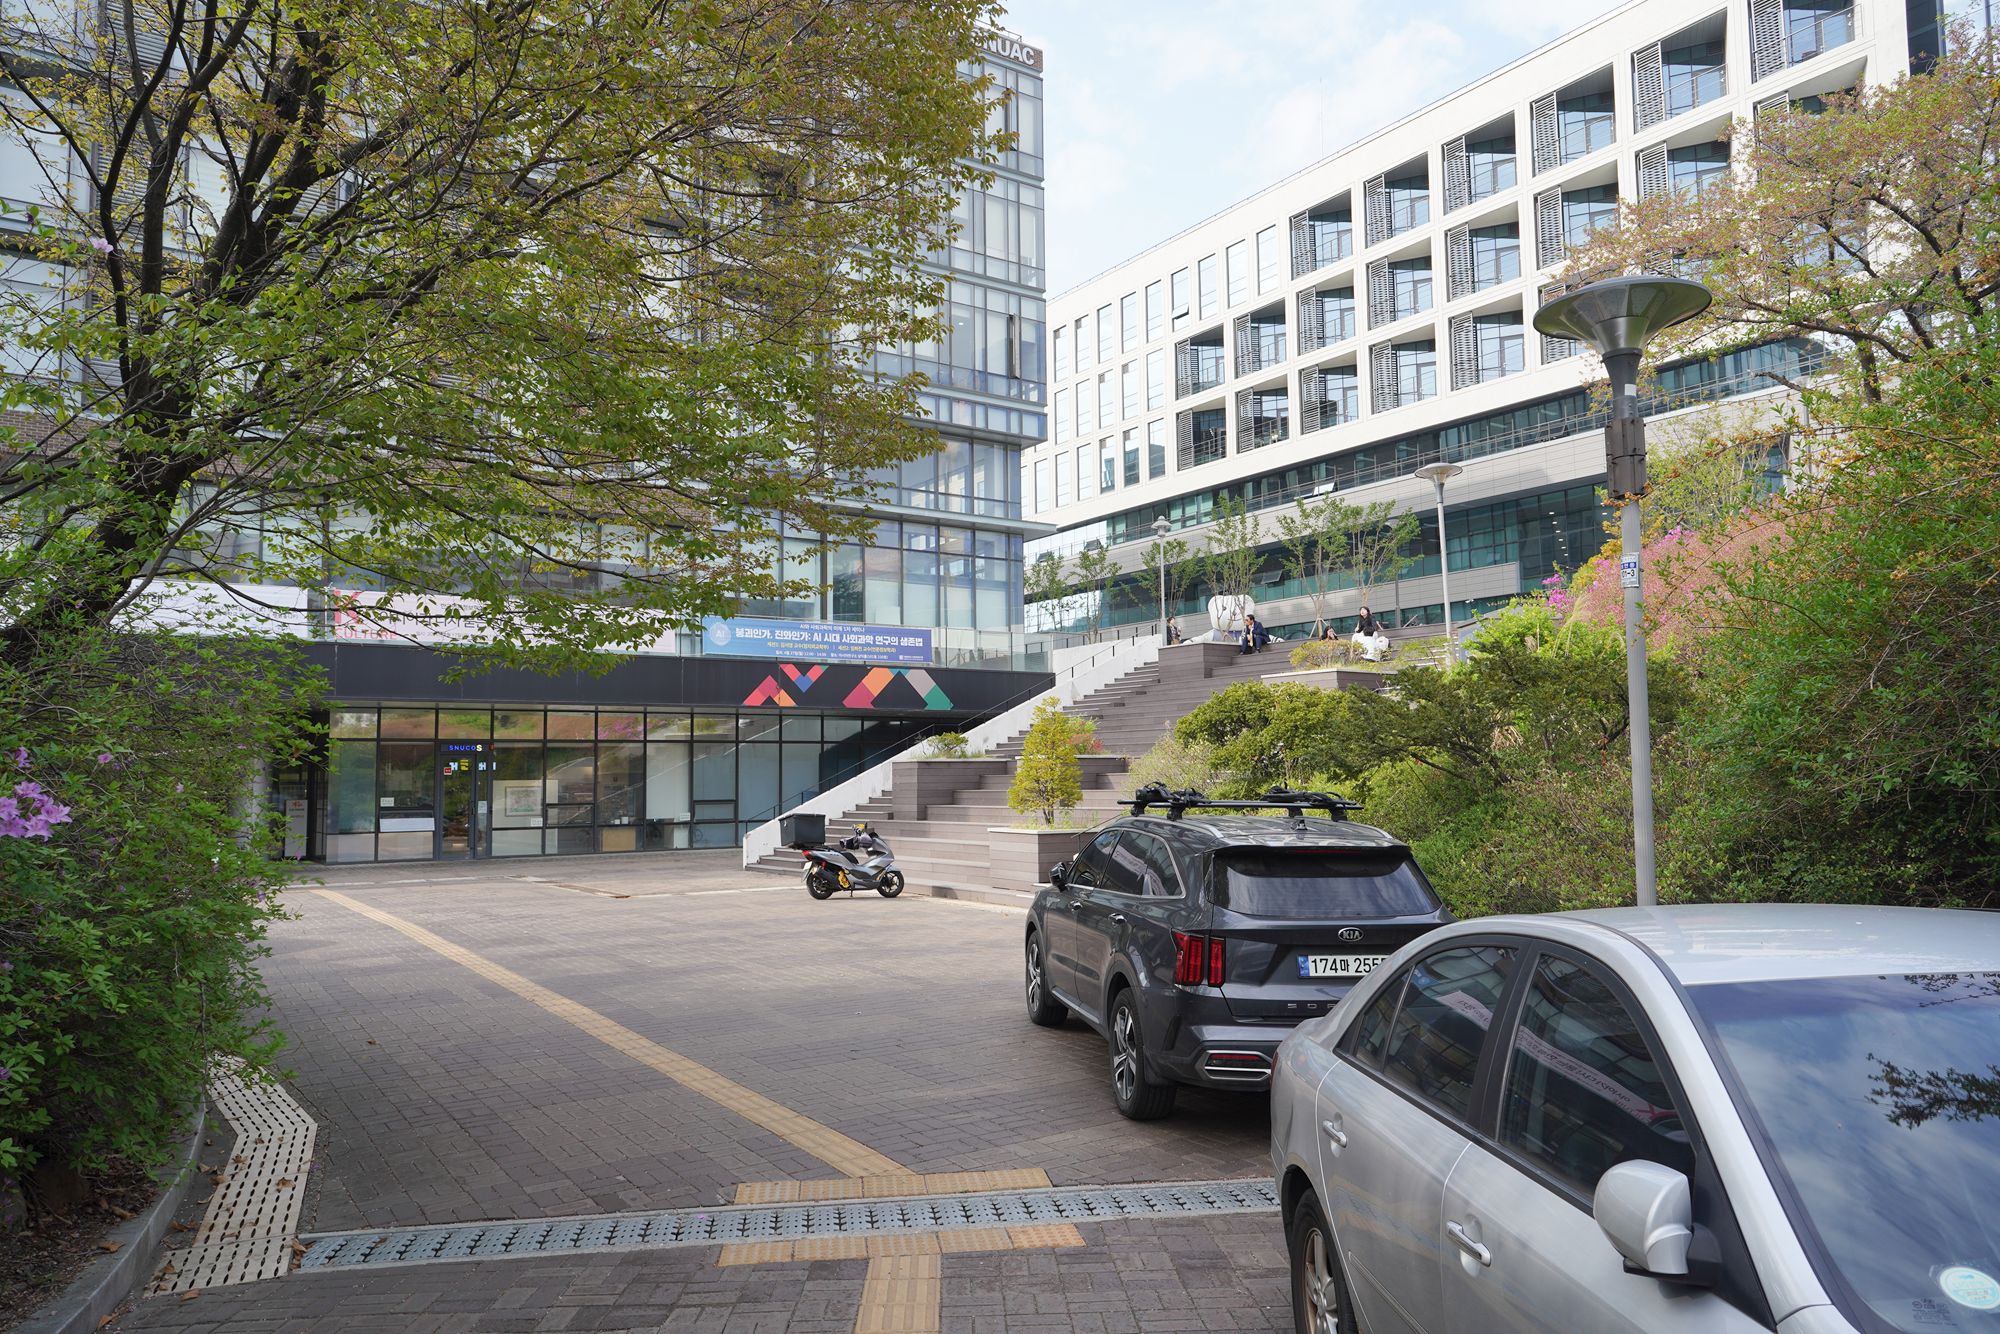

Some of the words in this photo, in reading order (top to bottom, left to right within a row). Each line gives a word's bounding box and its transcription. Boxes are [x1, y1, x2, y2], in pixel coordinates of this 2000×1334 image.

[813, 633, 822, 642] AI
[824, 633, 840, 643] 시대
[842, 634, 874, 644] 사회과학
[875, 636, 898, 645] 연구의
[900, 637, 923, 646] 생존법
[1342, 930, 1361, 939] KIA
[1311, 958, 1350, 974] 174마
[1353, 957, 1386, 974] 255
